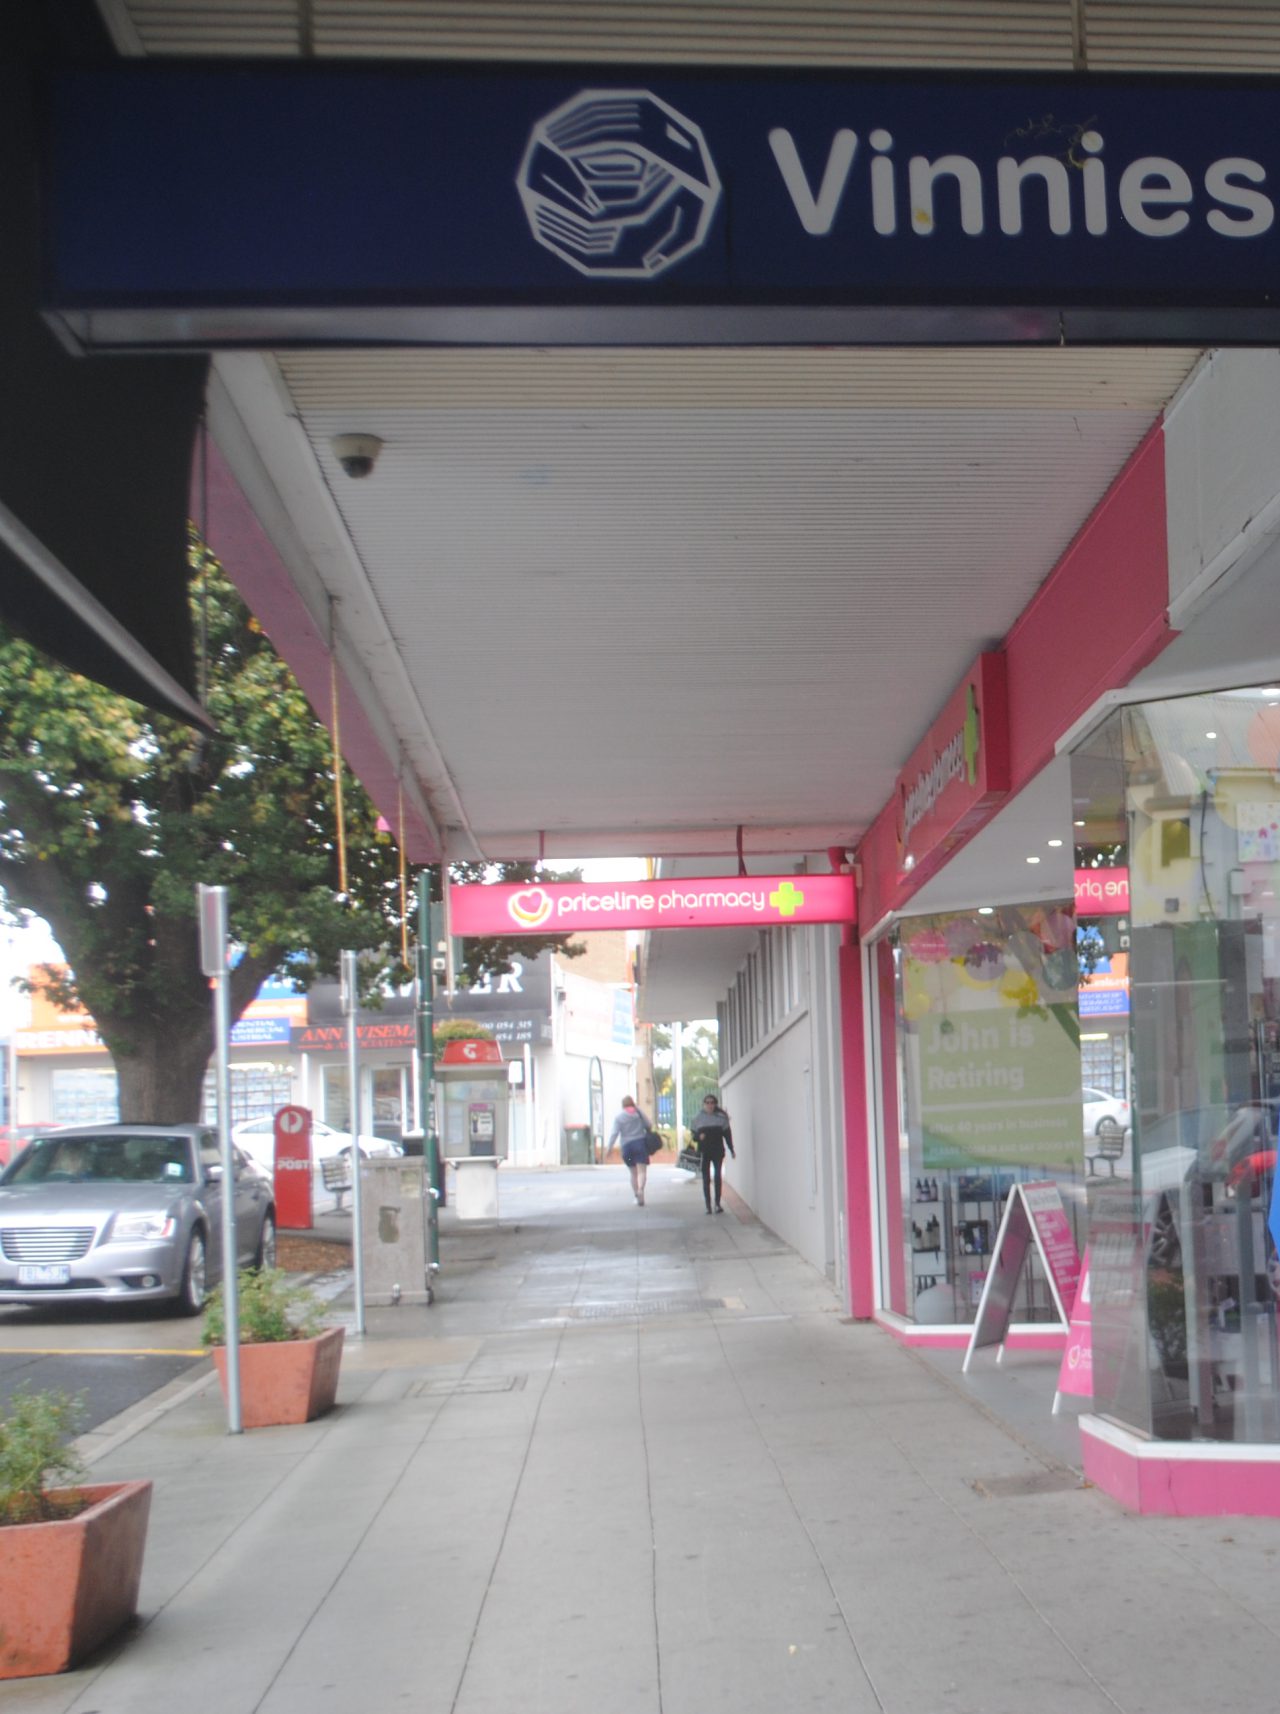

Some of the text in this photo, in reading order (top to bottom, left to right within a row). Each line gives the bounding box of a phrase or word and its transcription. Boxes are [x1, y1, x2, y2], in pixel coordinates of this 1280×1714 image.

[768, 127, 1275, 238] Vinnies
[557, 888, 765, 916] priceline pharmacy
[301, 1026, 343, 1041] ANN
[927, 1016, 1035, 1053] John is
[927, 1060, 1025, 1091] Retiring
